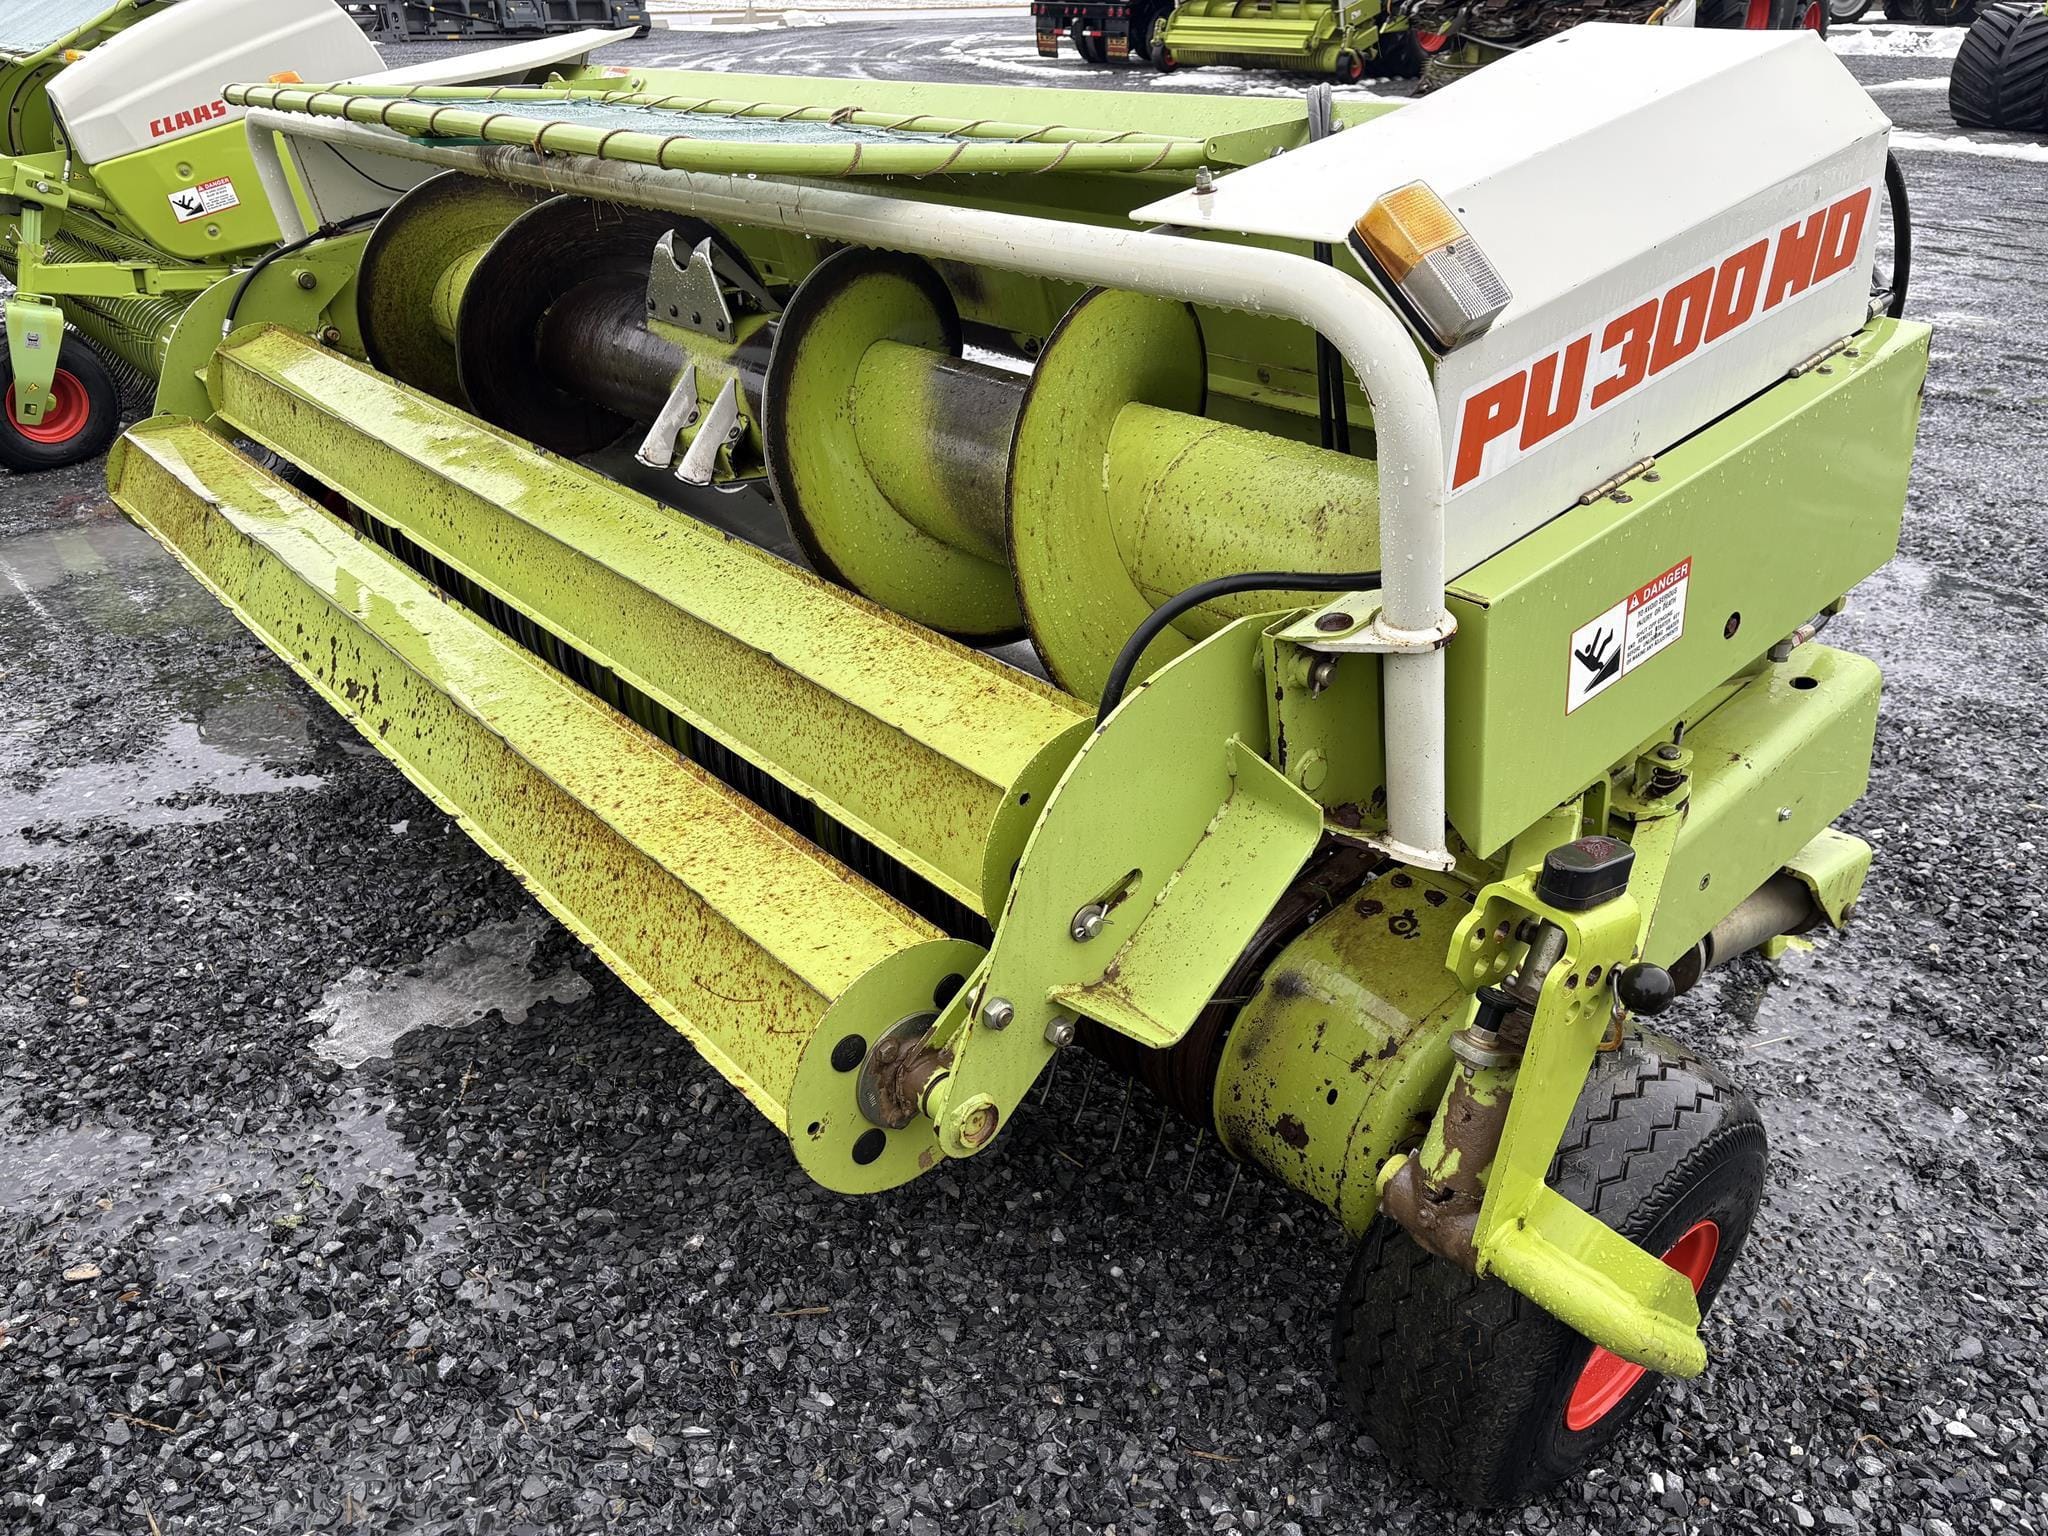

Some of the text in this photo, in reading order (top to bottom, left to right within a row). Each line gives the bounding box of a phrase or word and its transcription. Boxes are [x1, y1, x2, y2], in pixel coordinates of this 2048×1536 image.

[150, 100, 226, 137] CLAAS
[1452, 186, 1871, 491] PU 300 HD
[1643, 563, 1688, 601] DANGER
